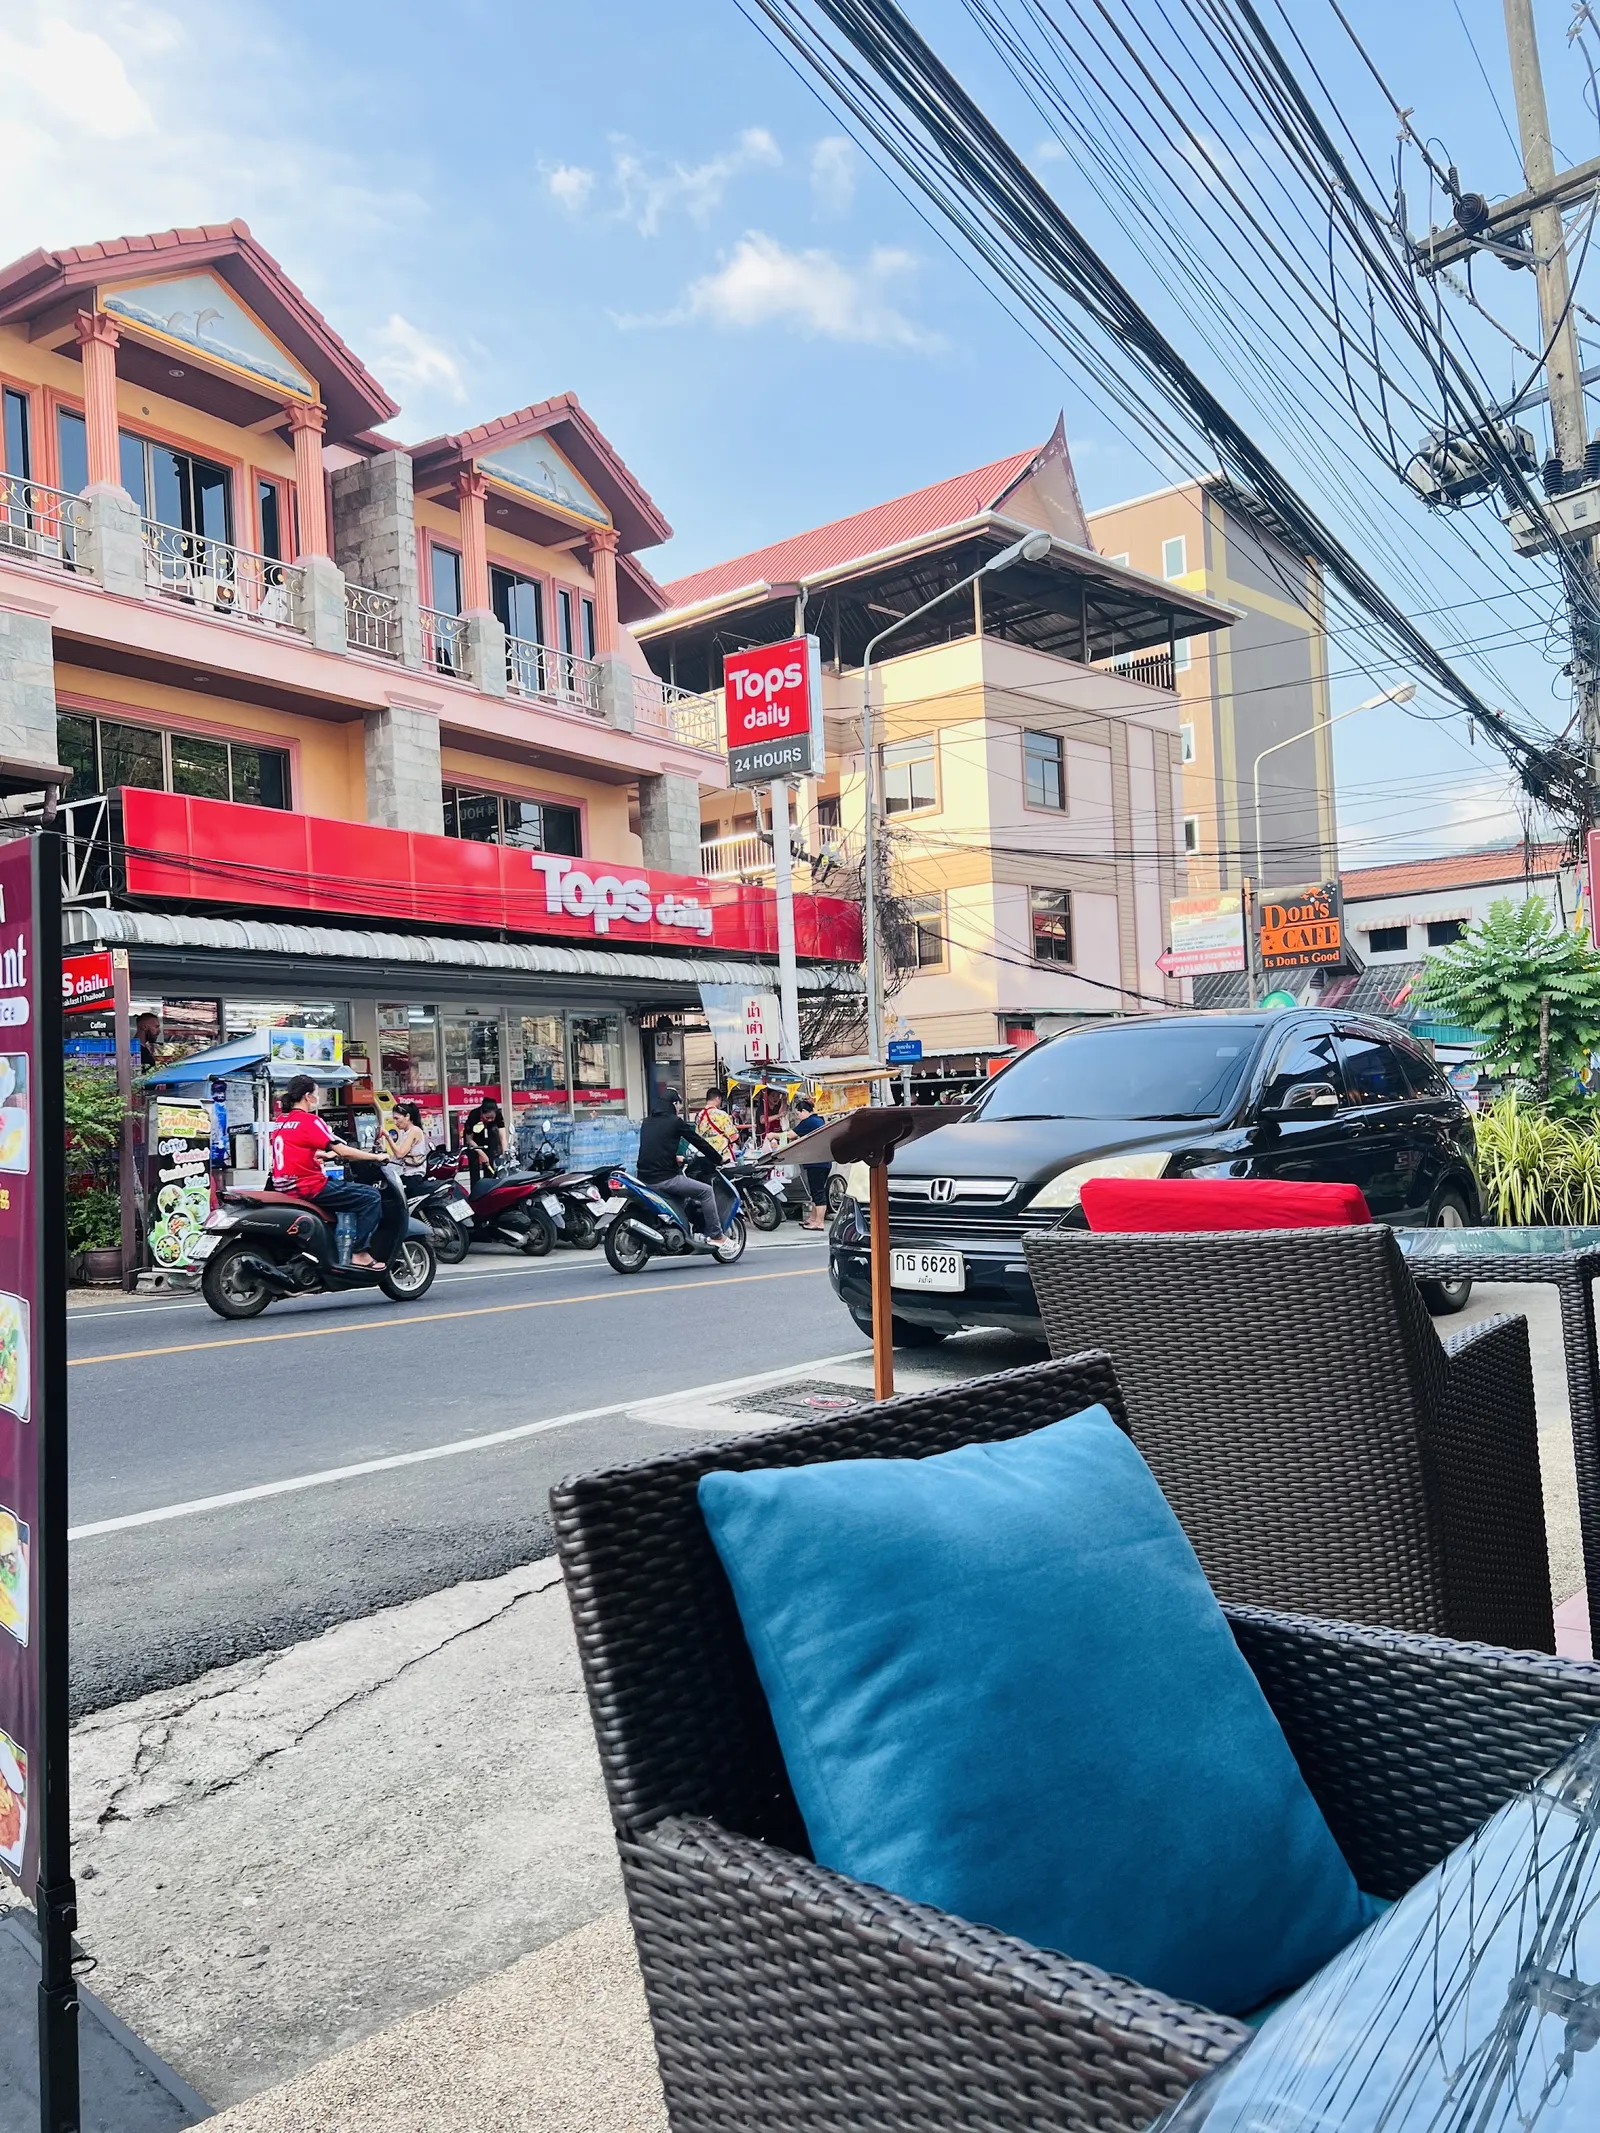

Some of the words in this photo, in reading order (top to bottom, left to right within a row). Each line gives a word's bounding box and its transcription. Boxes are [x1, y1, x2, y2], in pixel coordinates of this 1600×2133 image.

[728, 662, 803, 702] Tops
[744, 703, 790, 729] daily
[735, 757, 751, 773] 24
[753, 748, 802, 769] HOURS
[532, 855, 652, 934] Tops
[656, 894, 713, 937] daily
[1263, 901, 1330, 932] Don's
[1283, 924, 1338, 949] CAFE
[1264, 958, 1274, 968] Is
[1276, 955, 1297, 967] Don
[1300, 954, 1309, 964] Is
[1312, 951, 1340, 963] Good
[463, 1087, 477, 1096] Tops
[528, 1092, 542, 1100] Tops
[588, 1090, 601, 1098] Tops
[895, 1254, 916, 1271] กธ
[921, 1255, 956, 1274] 6628
